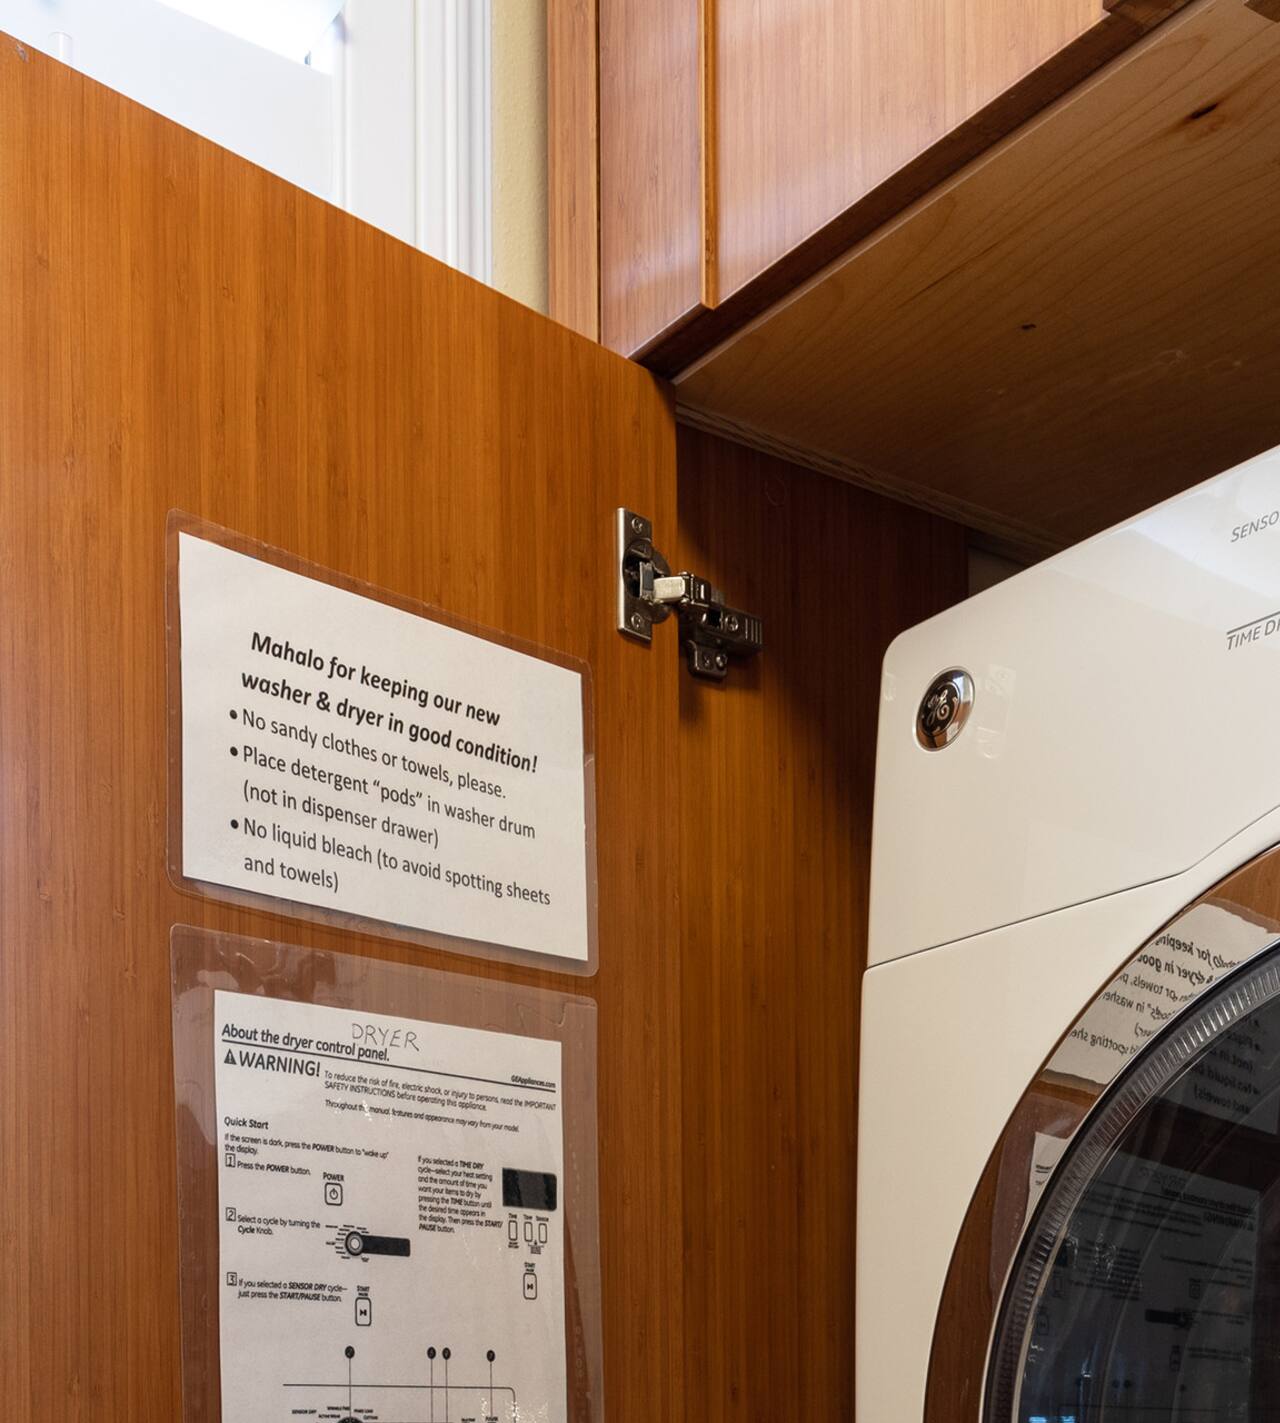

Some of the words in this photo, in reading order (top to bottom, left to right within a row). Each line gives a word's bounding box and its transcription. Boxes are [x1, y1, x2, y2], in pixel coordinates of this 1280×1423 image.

[1227, 625, 1261, 650] TIME
[251, 631, 324, 671] Mahalo
[327, 656, 356, 680] for
[360, 665, 428, 708] keeping
[433, 694, 462, 714] our
[465, 704, 500, 726] new
[241, 672, 312, 705] washer
[316, 691, 330, 712] &
[336, 698, 384, 727] dryer
[388, 712, 404, 734] in
[408, 724, 452, 748] good
[455, 738, 537, 773] condition!
[243, 708, 266, 730] No
[270, 720, 318, 749] sandy
[322, 732, 377, 762] clothes
[381, 752, 398, 767] or
[401, 755, 453, 787] towels,
[457, 772, 506, 798] please.
[243, 745, 286, 772] Place
[291, 758, 368, 794] detergent
[372, 779, 422, 807] “pods”
[427, 795, 440, 814] in
[444, 804, 495, 827] washer
[498, 815, 535, 839] drum
[243, 779, 277, 805] (not
[282, 790, 297, 810] in
[301, 795, 377, 829] dispenser
[381, 816, 438, 849] drawer)
[244, 817, 267, 839] No
[272, 823, 316, 850] liquid
[322, 834, 372, 864] bleach
[377, 848, 398, 870] (to
[402, 859, 441, 880] avoid
[445, 870, 503, 898] spotting
[506, 881, 550, 905] sheets
[244, 857, 274, 876] and
[279, 862, 338, 893] towels)
[221, 1023, 258, 1041] About
[260, 1029, 279, 1044] the
[282, 1032, 314, 1050] dryer
[315, 1040, 355, 1056] control
[357, 1047, 389, 1061] panel.
[239, 1050, 320, 1077] WARNING!
[352, 1023, 419, 1051] DRYER
[224, 1116, 247, 1127] Quick
[248, 1119, 269, 1130] Start
